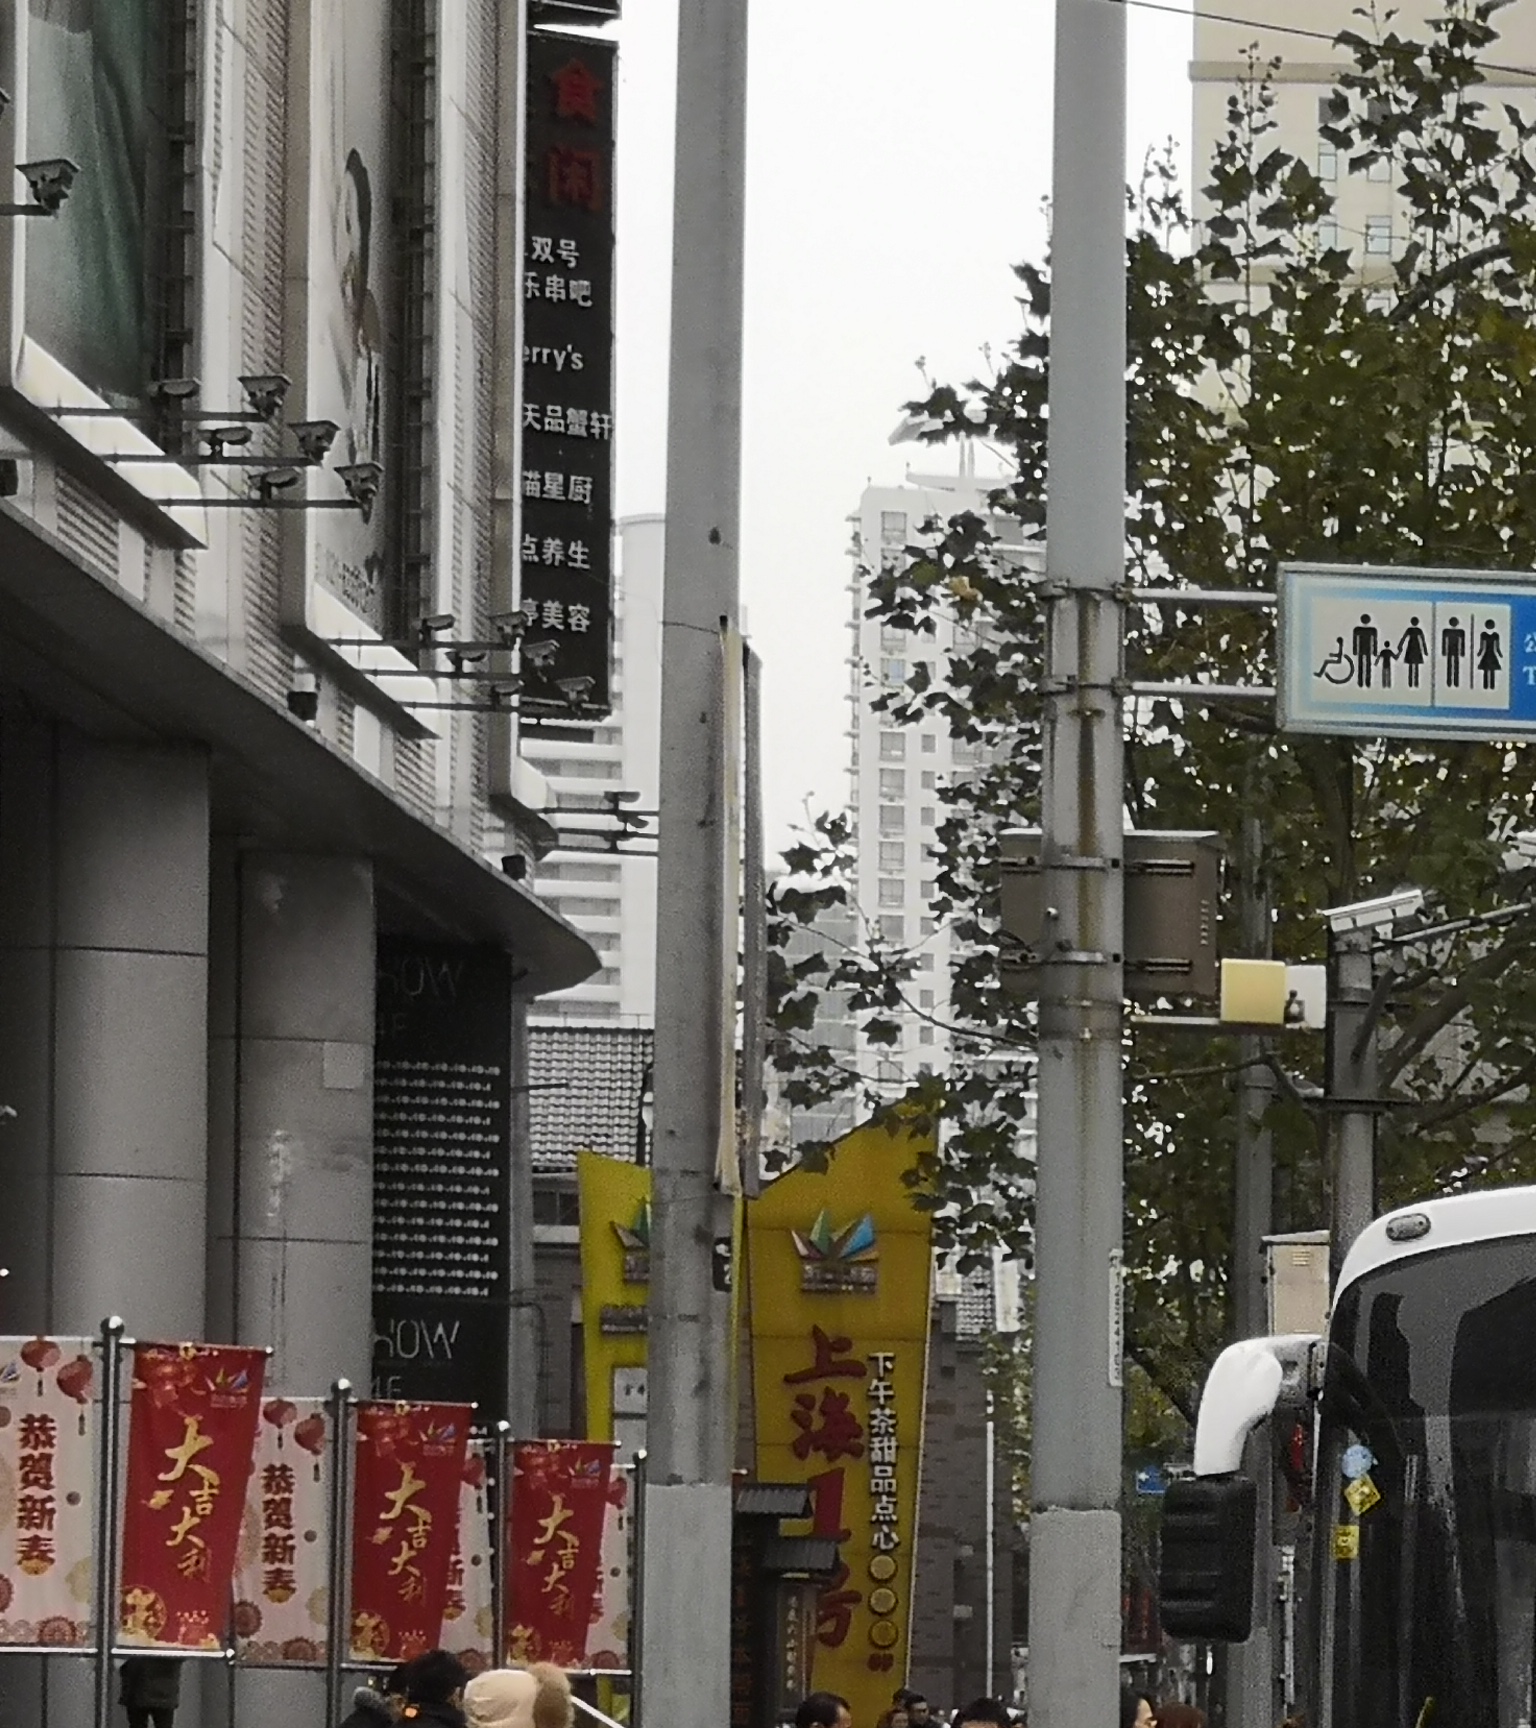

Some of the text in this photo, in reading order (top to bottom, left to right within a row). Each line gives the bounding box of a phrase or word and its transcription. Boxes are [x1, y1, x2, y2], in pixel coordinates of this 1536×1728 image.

[16, 1412, 59, 1567] 恭贺新春
[157, 1414, 222, 1584] 大吉大利
[867, 1351, 900, 1551] 下午茶甜品点心
[260, 1462, 298, 1595] 恭贺新春
[378, 1460, 435, 1607] 大吉大利
[531, 1493, 582, 1621] 大吉大利
